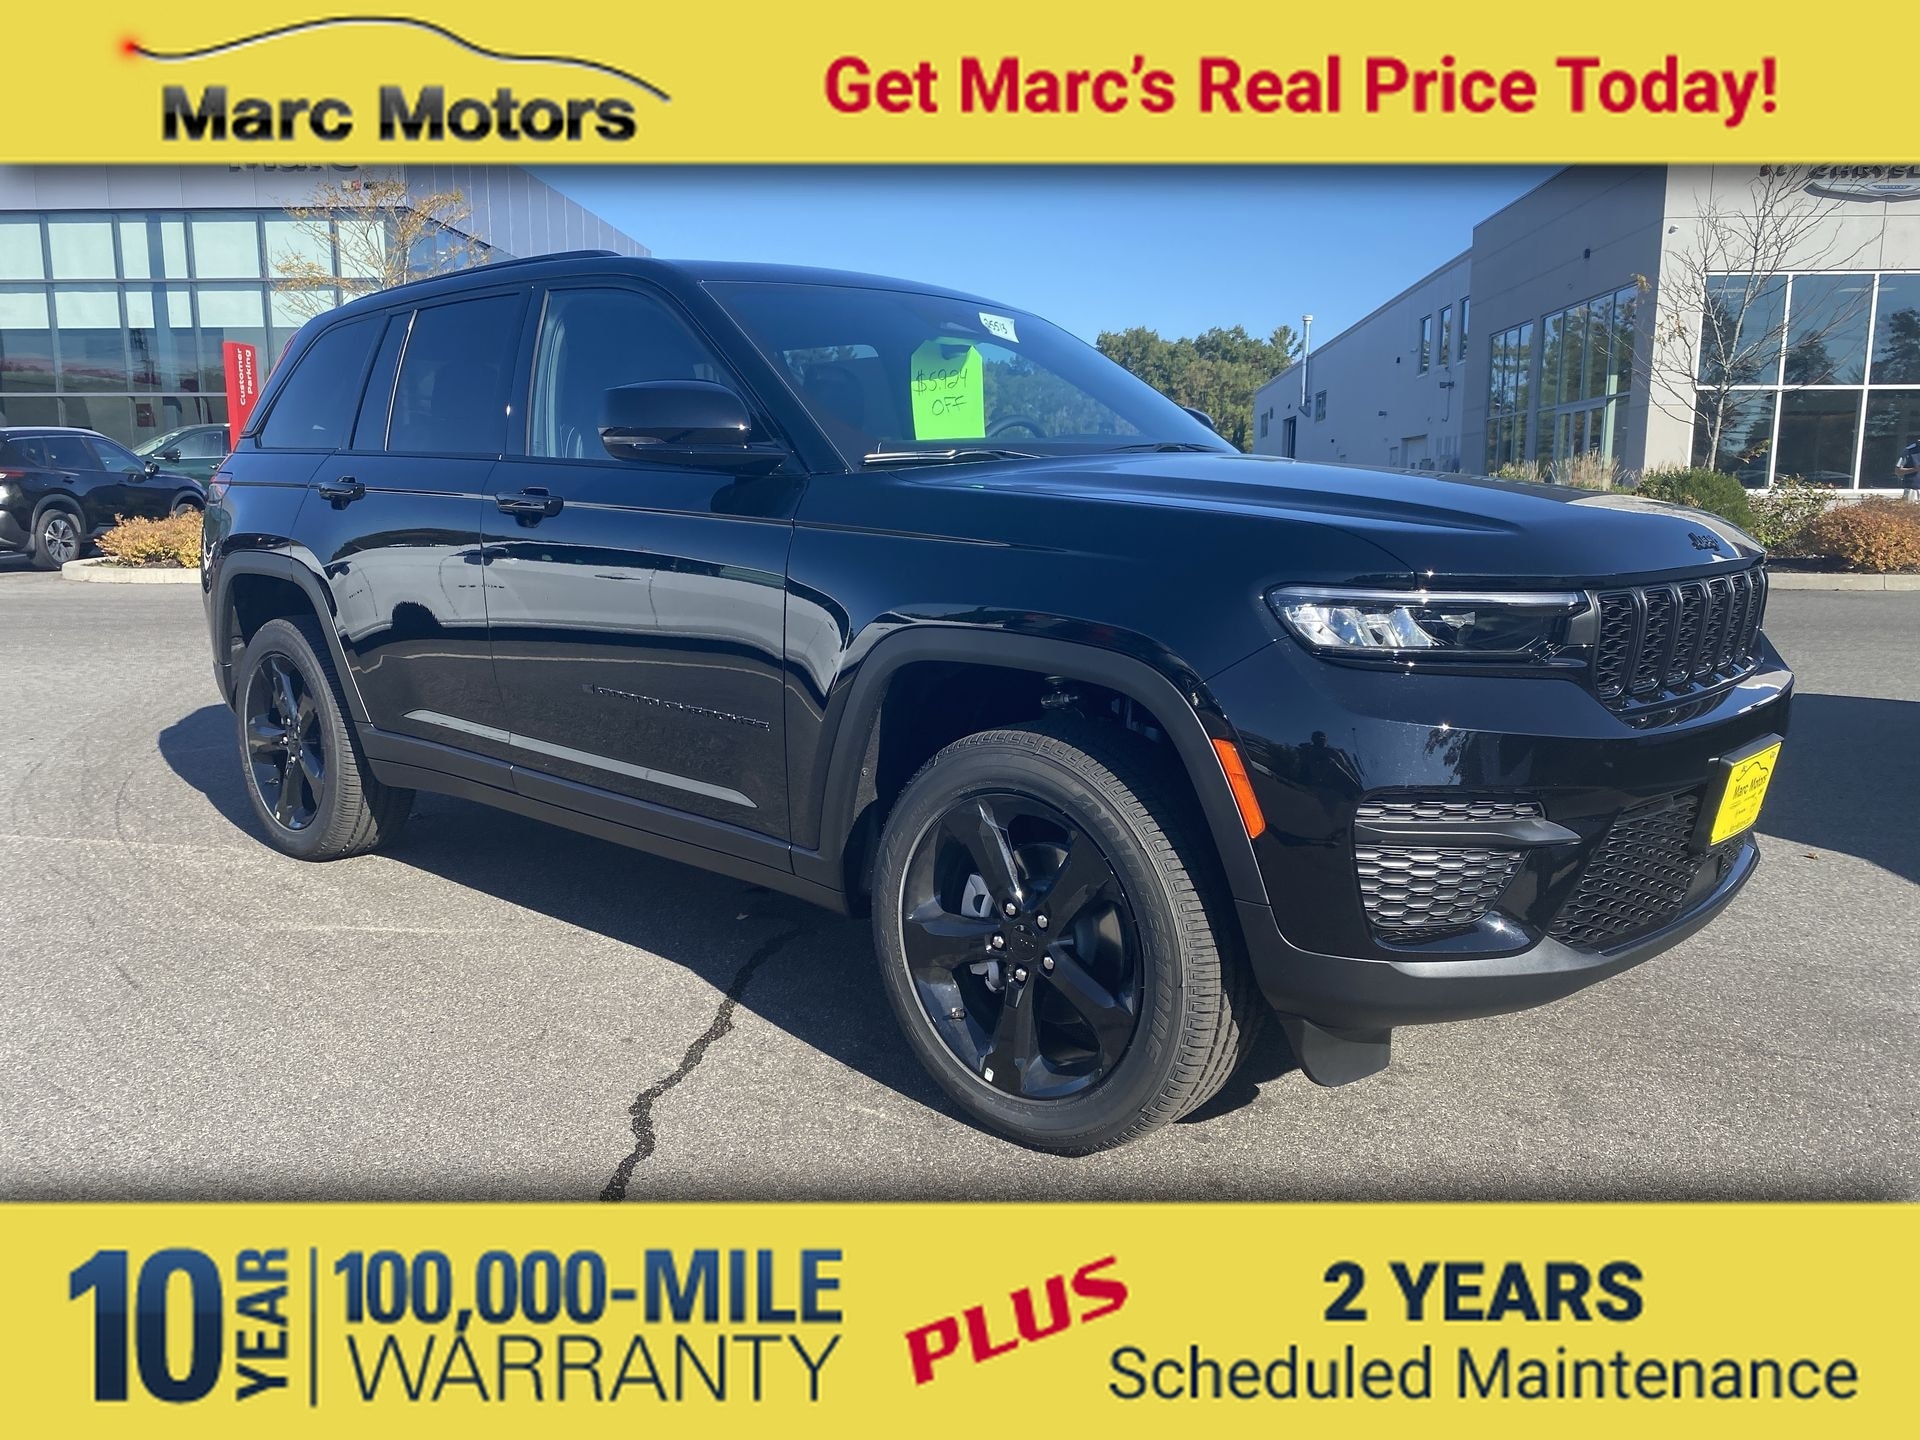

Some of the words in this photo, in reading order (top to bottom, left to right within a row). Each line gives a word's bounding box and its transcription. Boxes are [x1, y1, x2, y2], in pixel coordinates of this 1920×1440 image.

[236, 347, 246, 406] Customer
[245, 349, 254, 395] Parking
[931, 395, 968, 416] OFF
[1732, 785, 1750, 800] Marc
[1750, 775, 1768, 791] Motors
